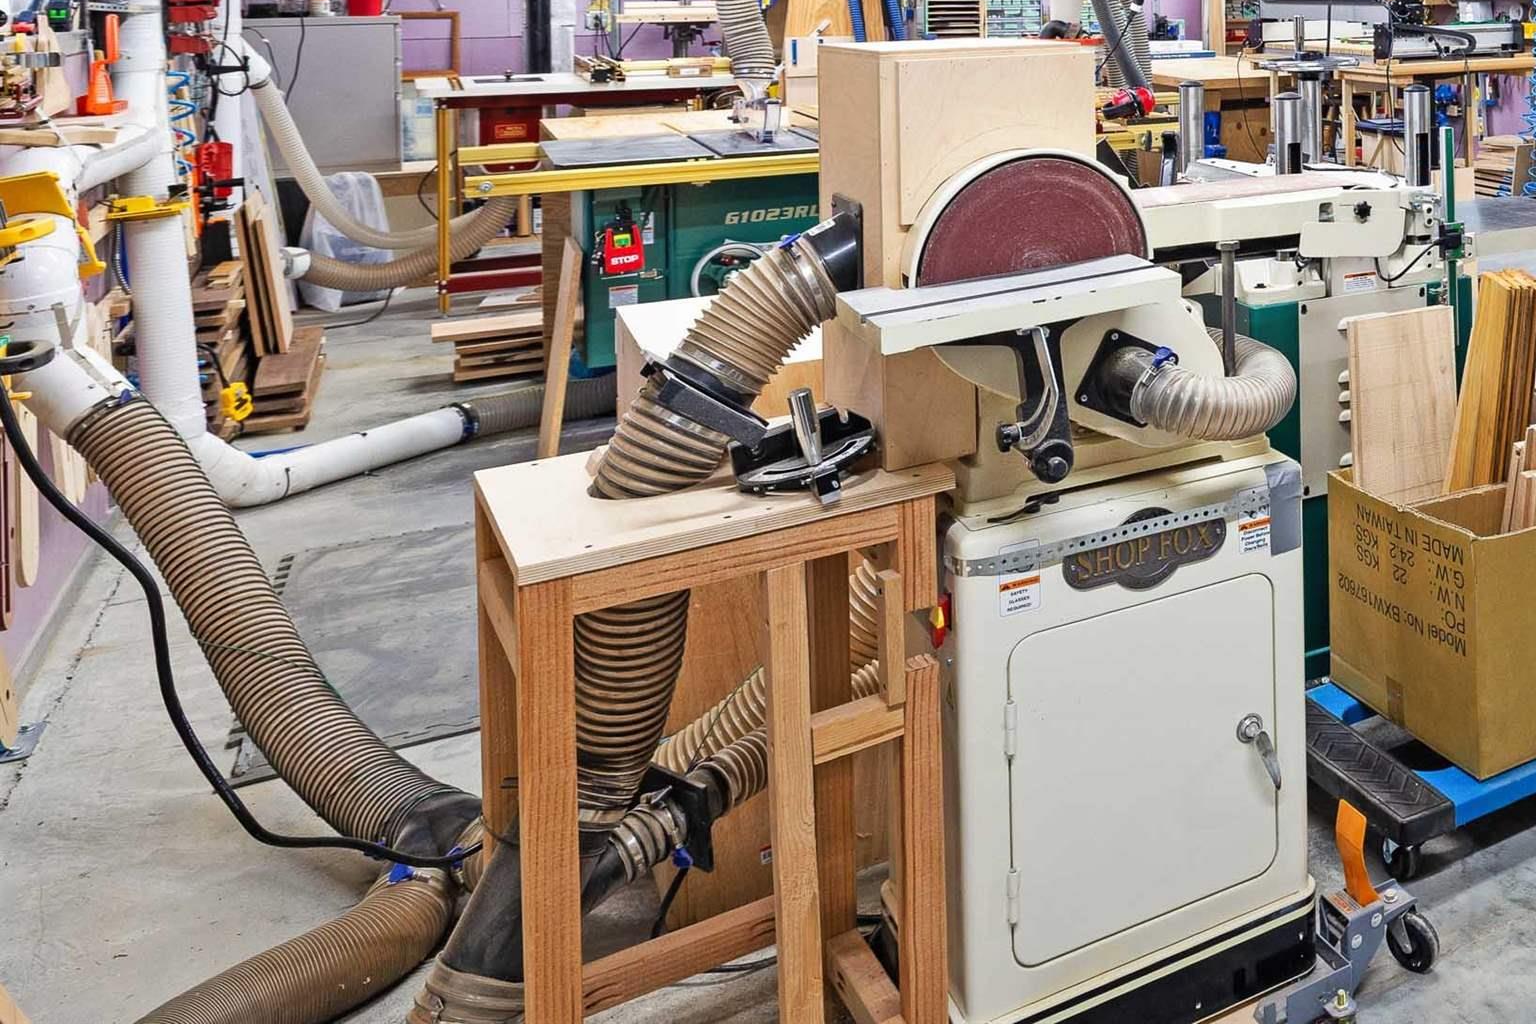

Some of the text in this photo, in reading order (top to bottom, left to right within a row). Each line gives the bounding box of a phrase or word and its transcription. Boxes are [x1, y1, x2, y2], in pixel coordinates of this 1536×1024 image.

[610, 254, 640, 266] STOP
[1357, 503, 1464, 565] MADE IN TAIWAN
[1077, 521, 1213, 581] SHOP FOX
[1389, 542, 1415, 567] 24.2
[1392, 564, 1408, 585] 22
[1338, 572, 1400, 623] BXW167602
[1428, 624, 1466, 656] Model
